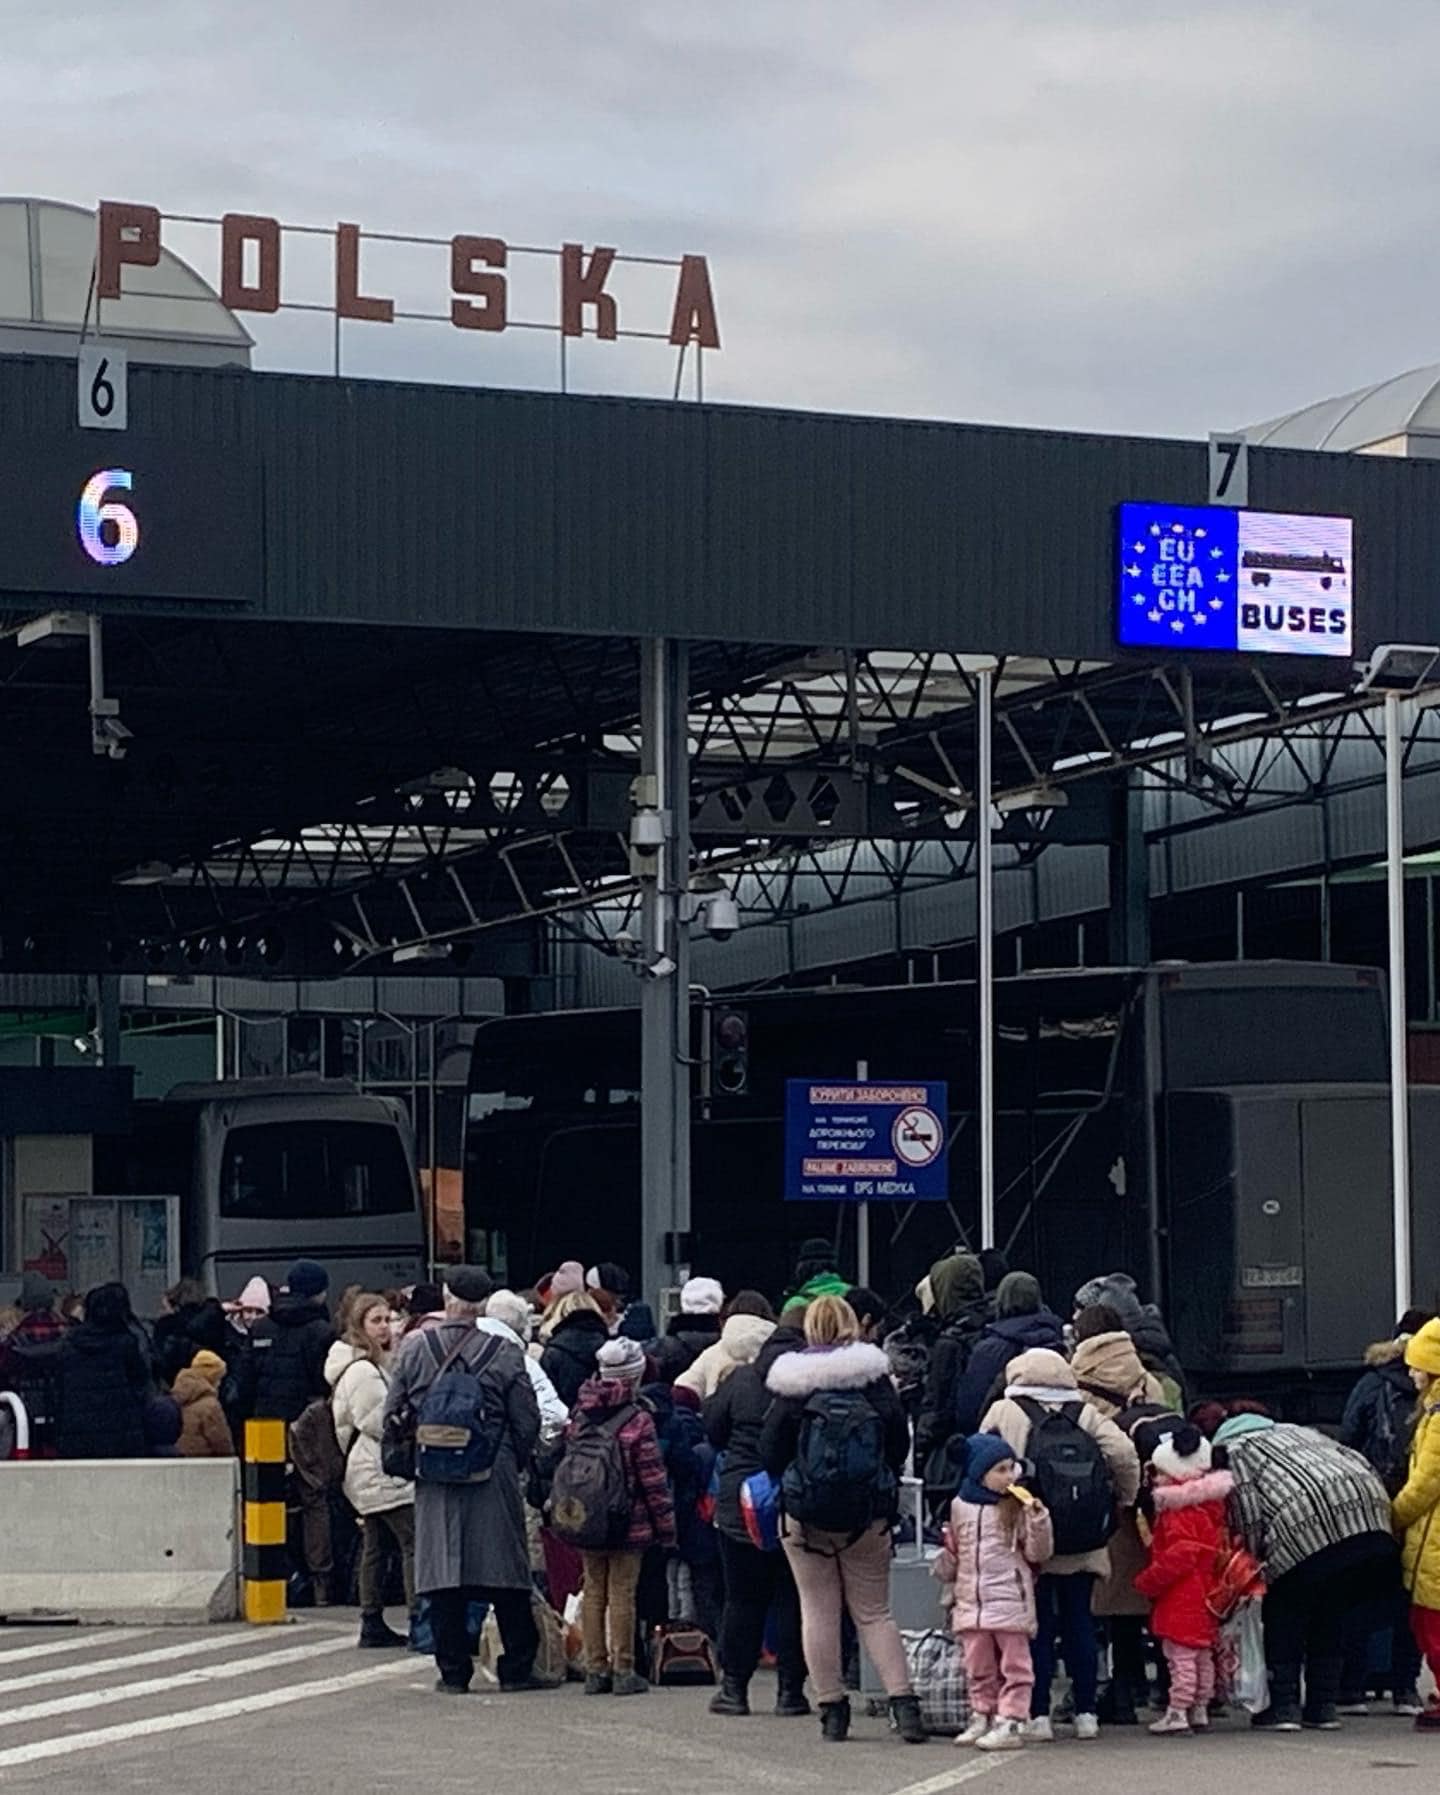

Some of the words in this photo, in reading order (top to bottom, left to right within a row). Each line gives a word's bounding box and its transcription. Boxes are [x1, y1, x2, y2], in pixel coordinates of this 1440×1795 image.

[98, 200, 720, 349] POLSKA
[90, 358, 114, 417] 6
[1216, 443, 1242, 497] 7
[77, 467, 139, 565] 6
[1152, 563, 1204, 588] EEA
[1159, 538, 1195, 562] EU
[1242, 604, 1346, 634] BUSES
